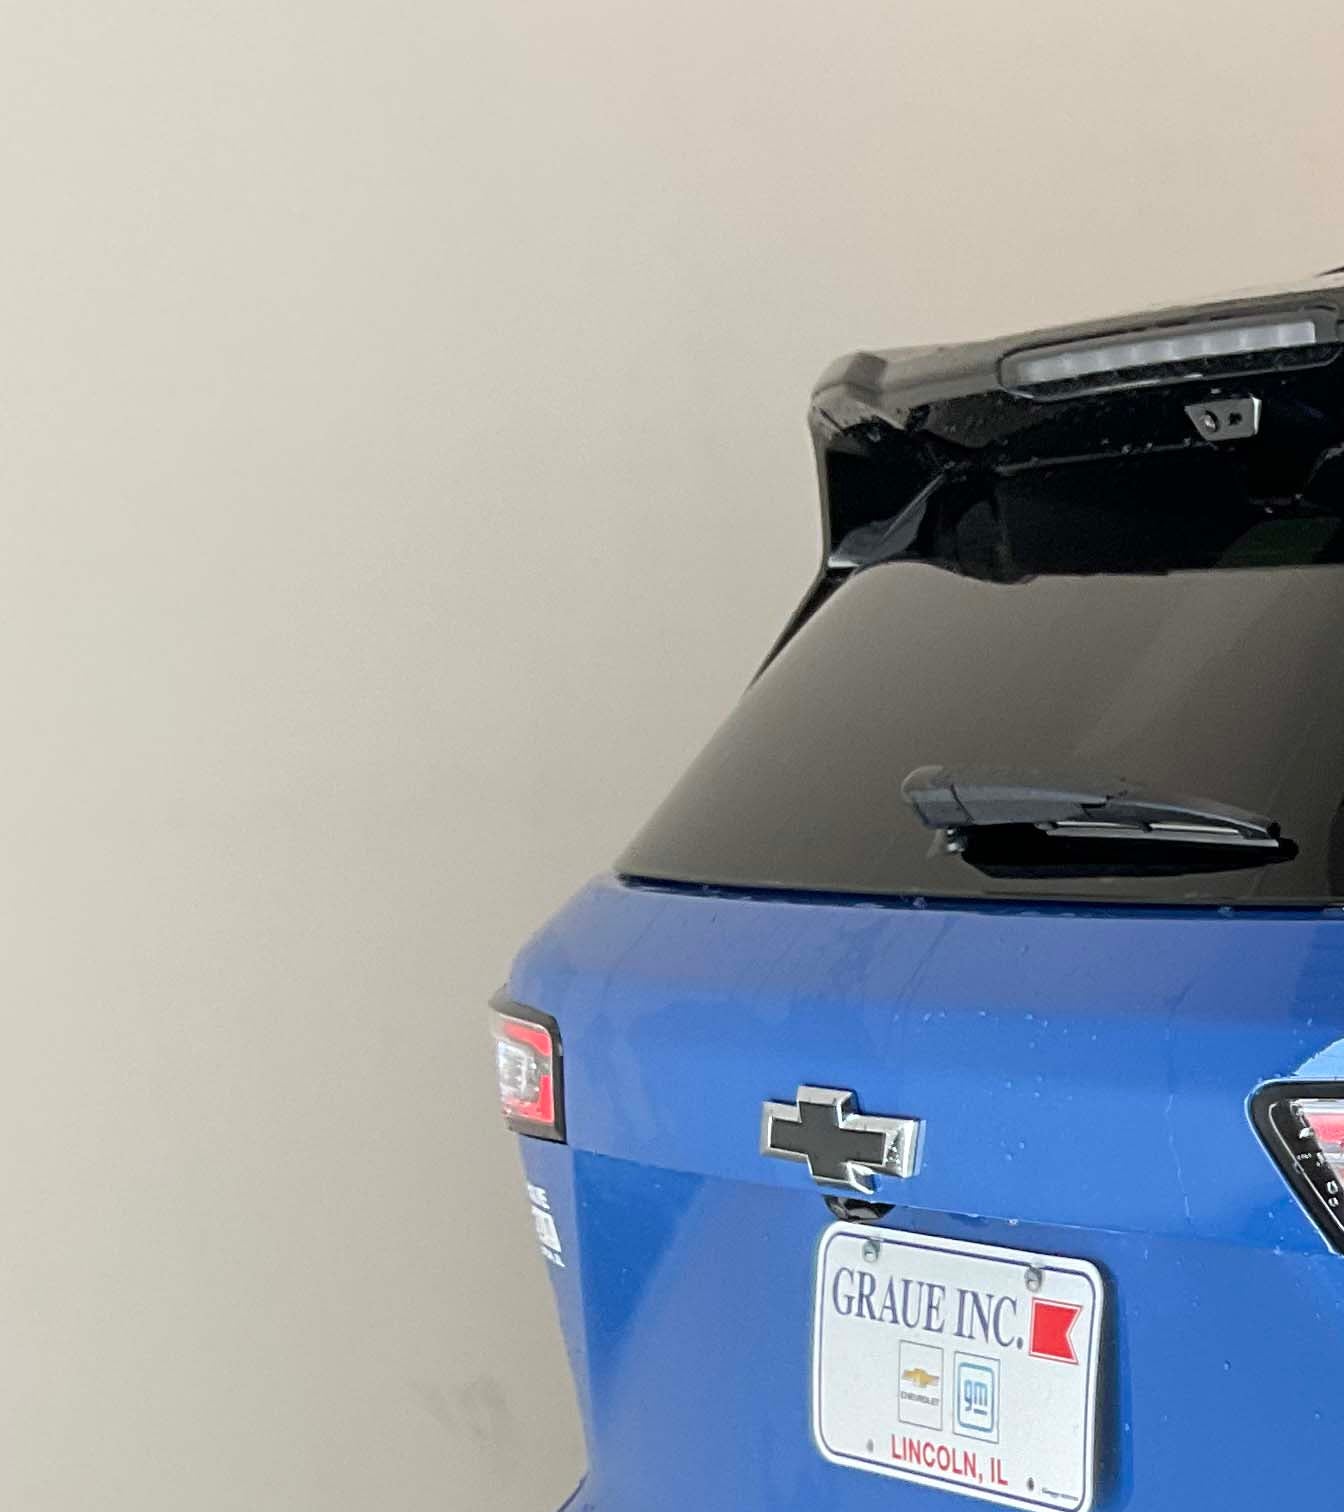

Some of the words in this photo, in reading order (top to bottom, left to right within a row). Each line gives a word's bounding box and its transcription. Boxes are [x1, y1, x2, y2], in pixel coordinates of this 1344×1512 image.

[832, 1267, 946, 1334] GRAUE
[953, 1288, 1024, 1351] INC.
[891, 1434, 983, 1483] LINCOLN,
[991, 1457, 1008, 1486] IL
